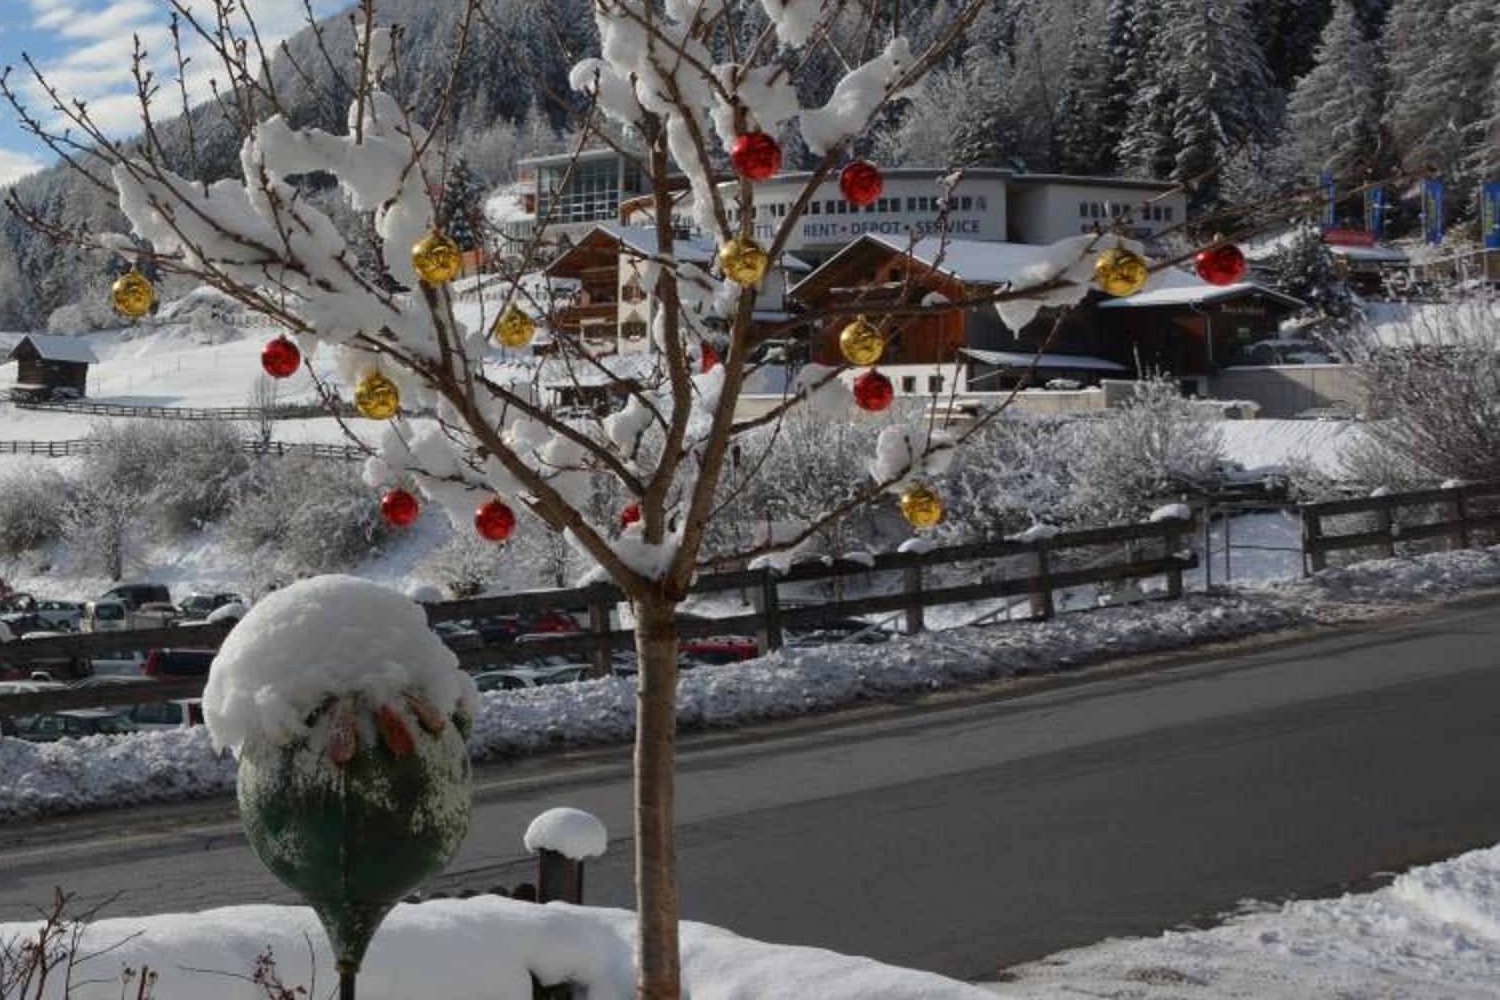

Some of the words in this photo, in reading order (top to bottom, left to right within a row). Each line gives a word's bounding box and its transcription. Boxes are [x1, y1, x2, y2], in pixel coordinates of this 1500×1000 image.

[803, 223, 838, 237] RENT
[851, 220, 900, 235] DEPOT
[915, 219, 981, 234] SERVICE
